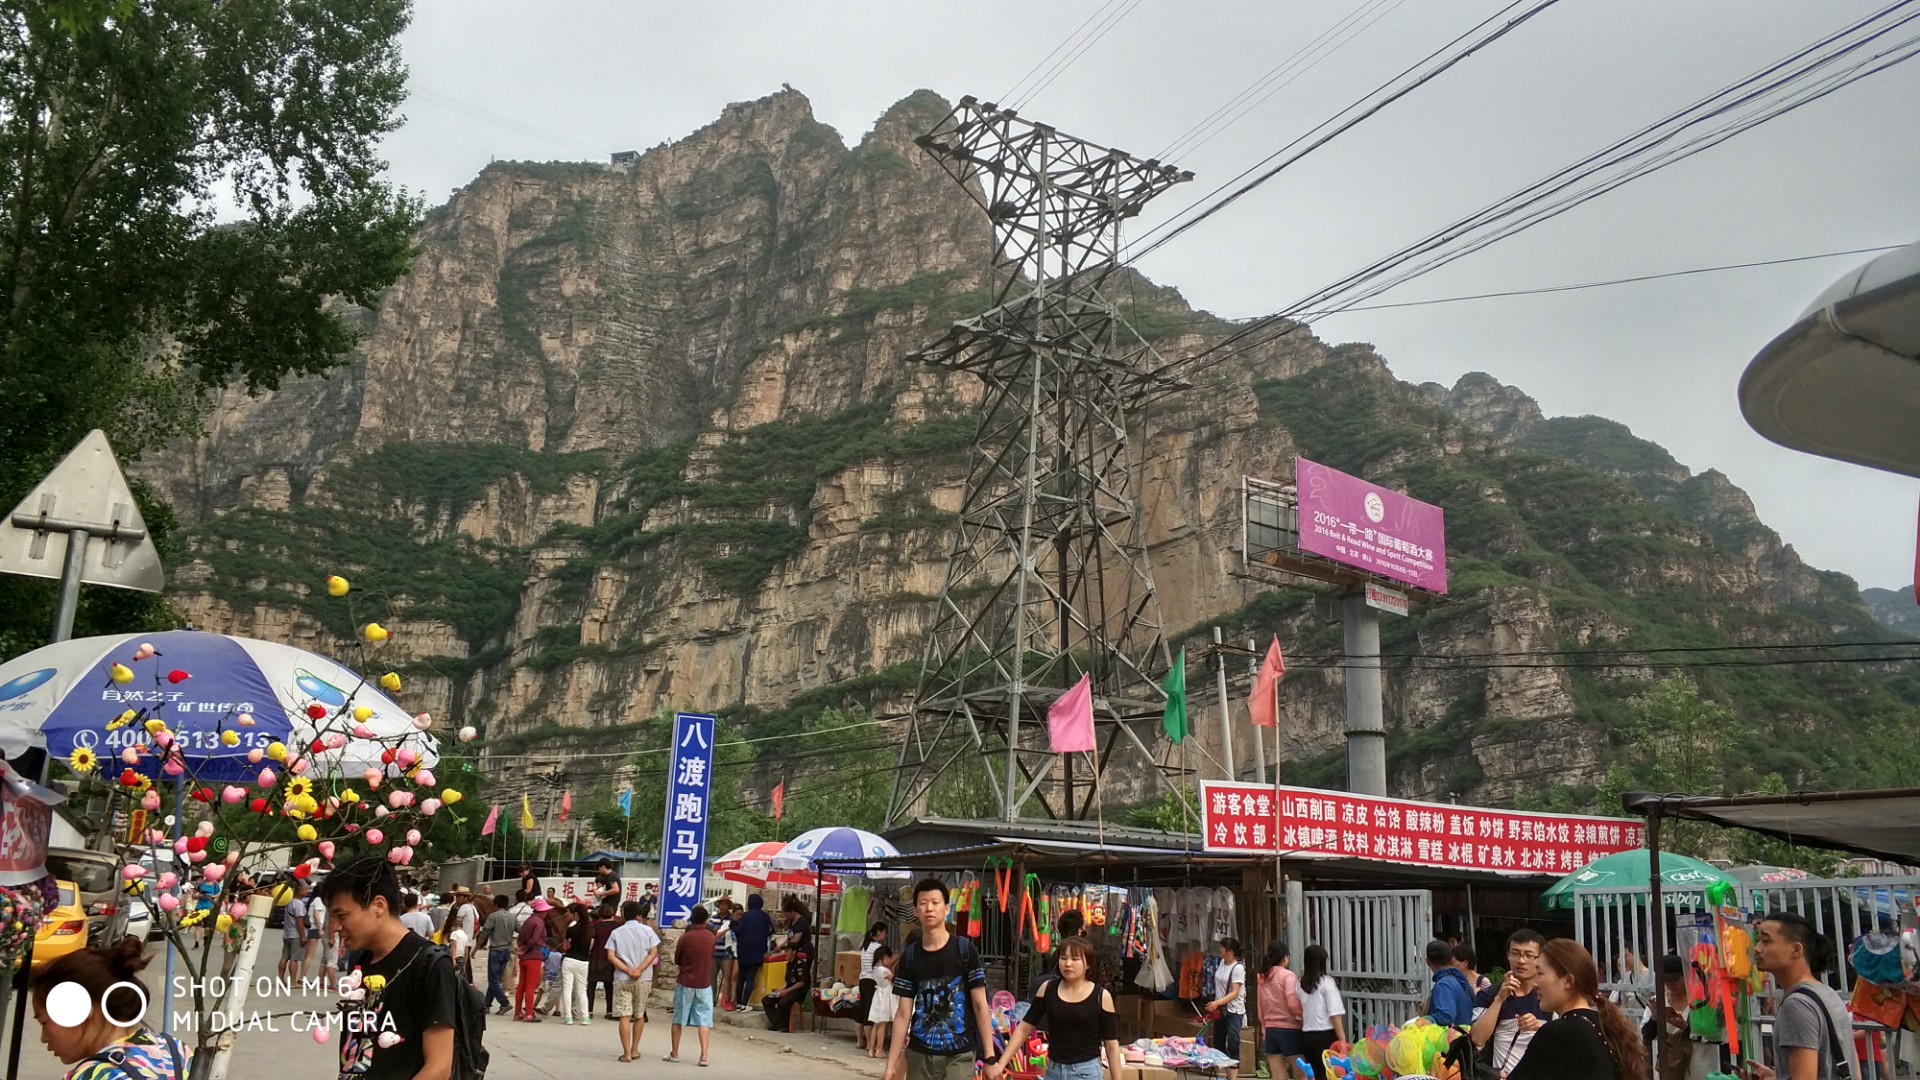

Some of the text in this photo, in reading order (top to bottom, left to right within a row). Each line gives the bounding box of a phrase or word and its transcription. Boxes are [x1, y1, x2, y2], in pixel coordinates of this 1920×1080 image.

[1314, 525, 1329, 536] 2016
[1330, 530, 1340, 540] Belt
[1347, 536, 1360, 546] Road
[1362, 540, 1376, 552] Wine
[1376, 544, 1386, 555] and
[1387, 548, 1401, 561] Spirit
[1402, 554, 1434, 571] Competition
[102, 690, 184, 702] 自然之子
[178, 702, 254, 713] 矿世传奇
[668, 722, 708, 898] 八渡跑马场
[1282, 796, 1337, 822] 山西削面
[1341, 802, 1368, 827] 凉皮
[1374, 805, 1401, 829] 饸饹
[1405, 809, 1445, 834] 酸辣粉
[1450, 814, 1475, 836] 盖饭
[1479, 817, 1504, 839] 炒饼
[1509, 819, 1570, 844] 野菜馅水饺
[1574, 823, 1621, 846] 杂粮煎饼
[1625, 826, 1646, 848] 凉菜
[1284, 825, 1337, 851] 冰镇啤酒
[1343, 830, 1369, 854] 饮料
[1374, 833, 1413, 858] 冰淇淋
[1417, 838, 1443, 861] 雪糕
[1448, 842, 1473, 864] 冰棍
[1478, 844, 1516, 866] 矿泉水
[1520, 848, 1556, 870] 北冰洋
[1561, 849, 1584, 871] 烤串
